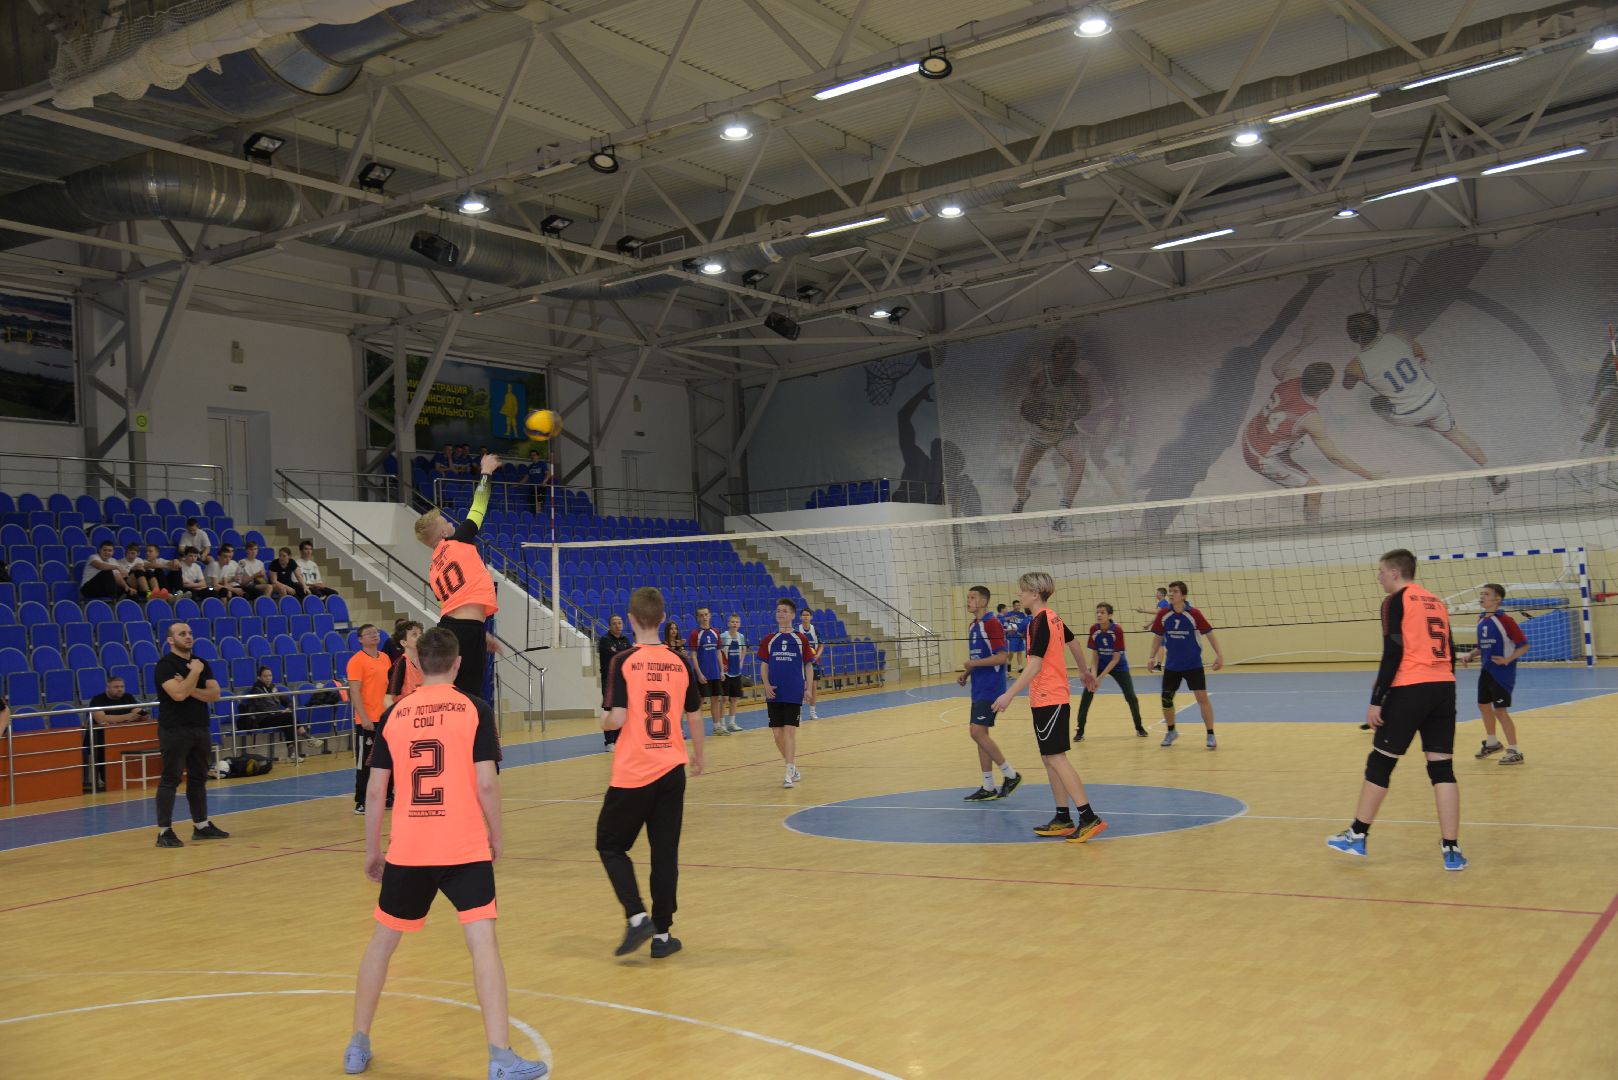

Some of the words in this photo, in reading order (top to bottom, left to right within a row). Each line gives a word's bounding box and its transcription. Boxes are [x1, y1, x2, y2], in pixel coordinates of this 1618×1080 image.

[1384, 358, 1418, 393] 10
[436, 560, 466, 602] 10
[1427, 616, 1447, 659] 5
[647, 673, 662, 681] СОШ
[396, 707, 411, 718] МОУ
[413, 716, 435, 728] СОШ
[645, 691, 671, 740] 8
[409, 738, 445, 805] 2
